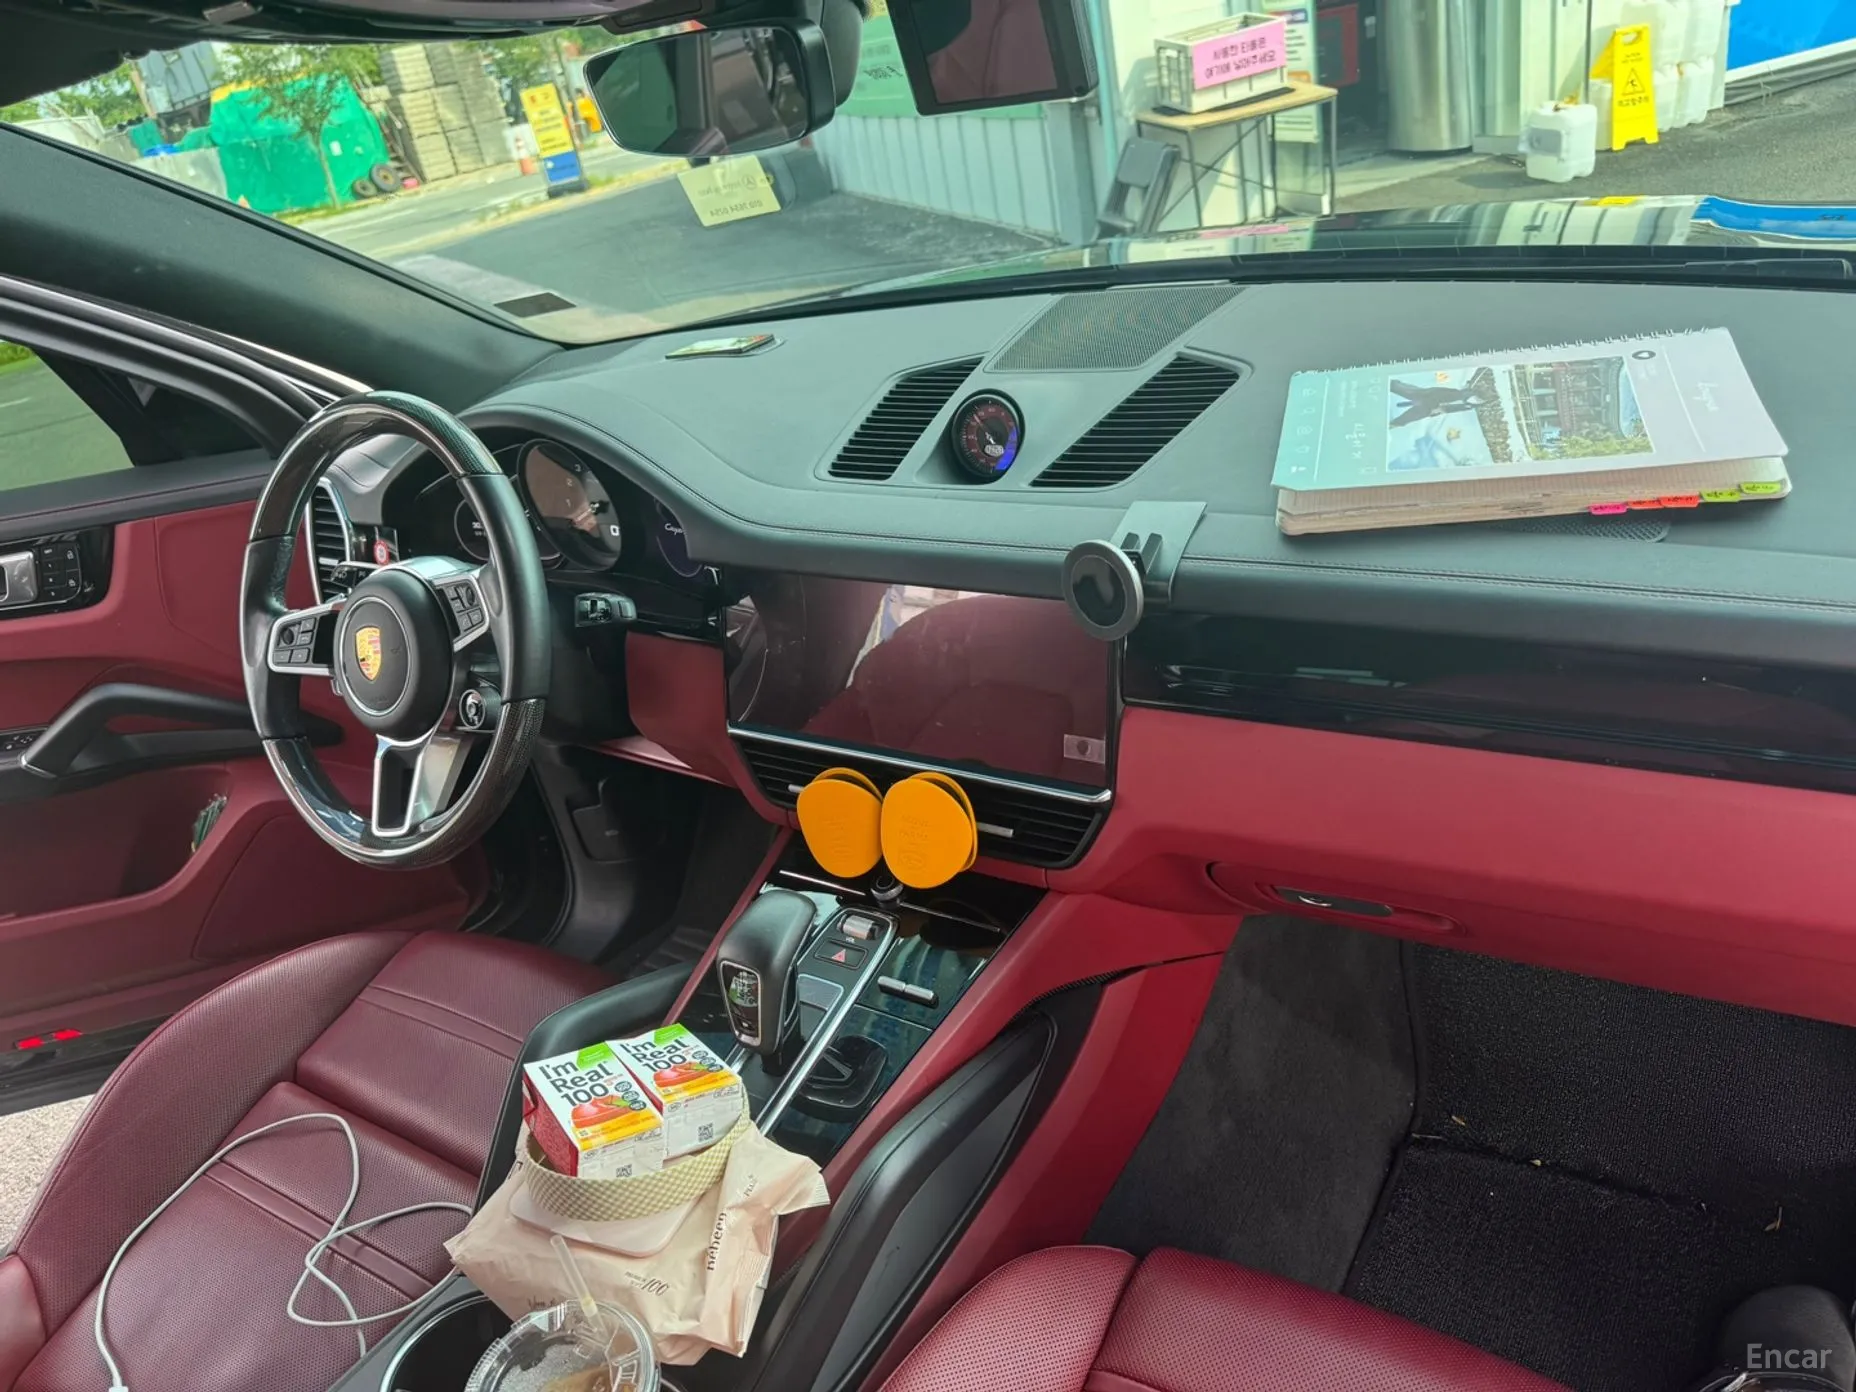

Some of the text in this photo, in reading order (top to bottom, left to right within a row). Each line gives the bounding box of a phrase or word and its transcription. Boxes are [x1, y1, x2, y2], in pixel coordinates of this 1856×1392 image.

[620, 1040, 656, 1054] I'm
[631, 1039, 689, 1063] Real
[538, 1061, 578, 1080] I'm
[642, 1054, 687, 1072] 100
[549, 1062, 613, 1093] Real
[561, 1083, 609, 1107] 100
